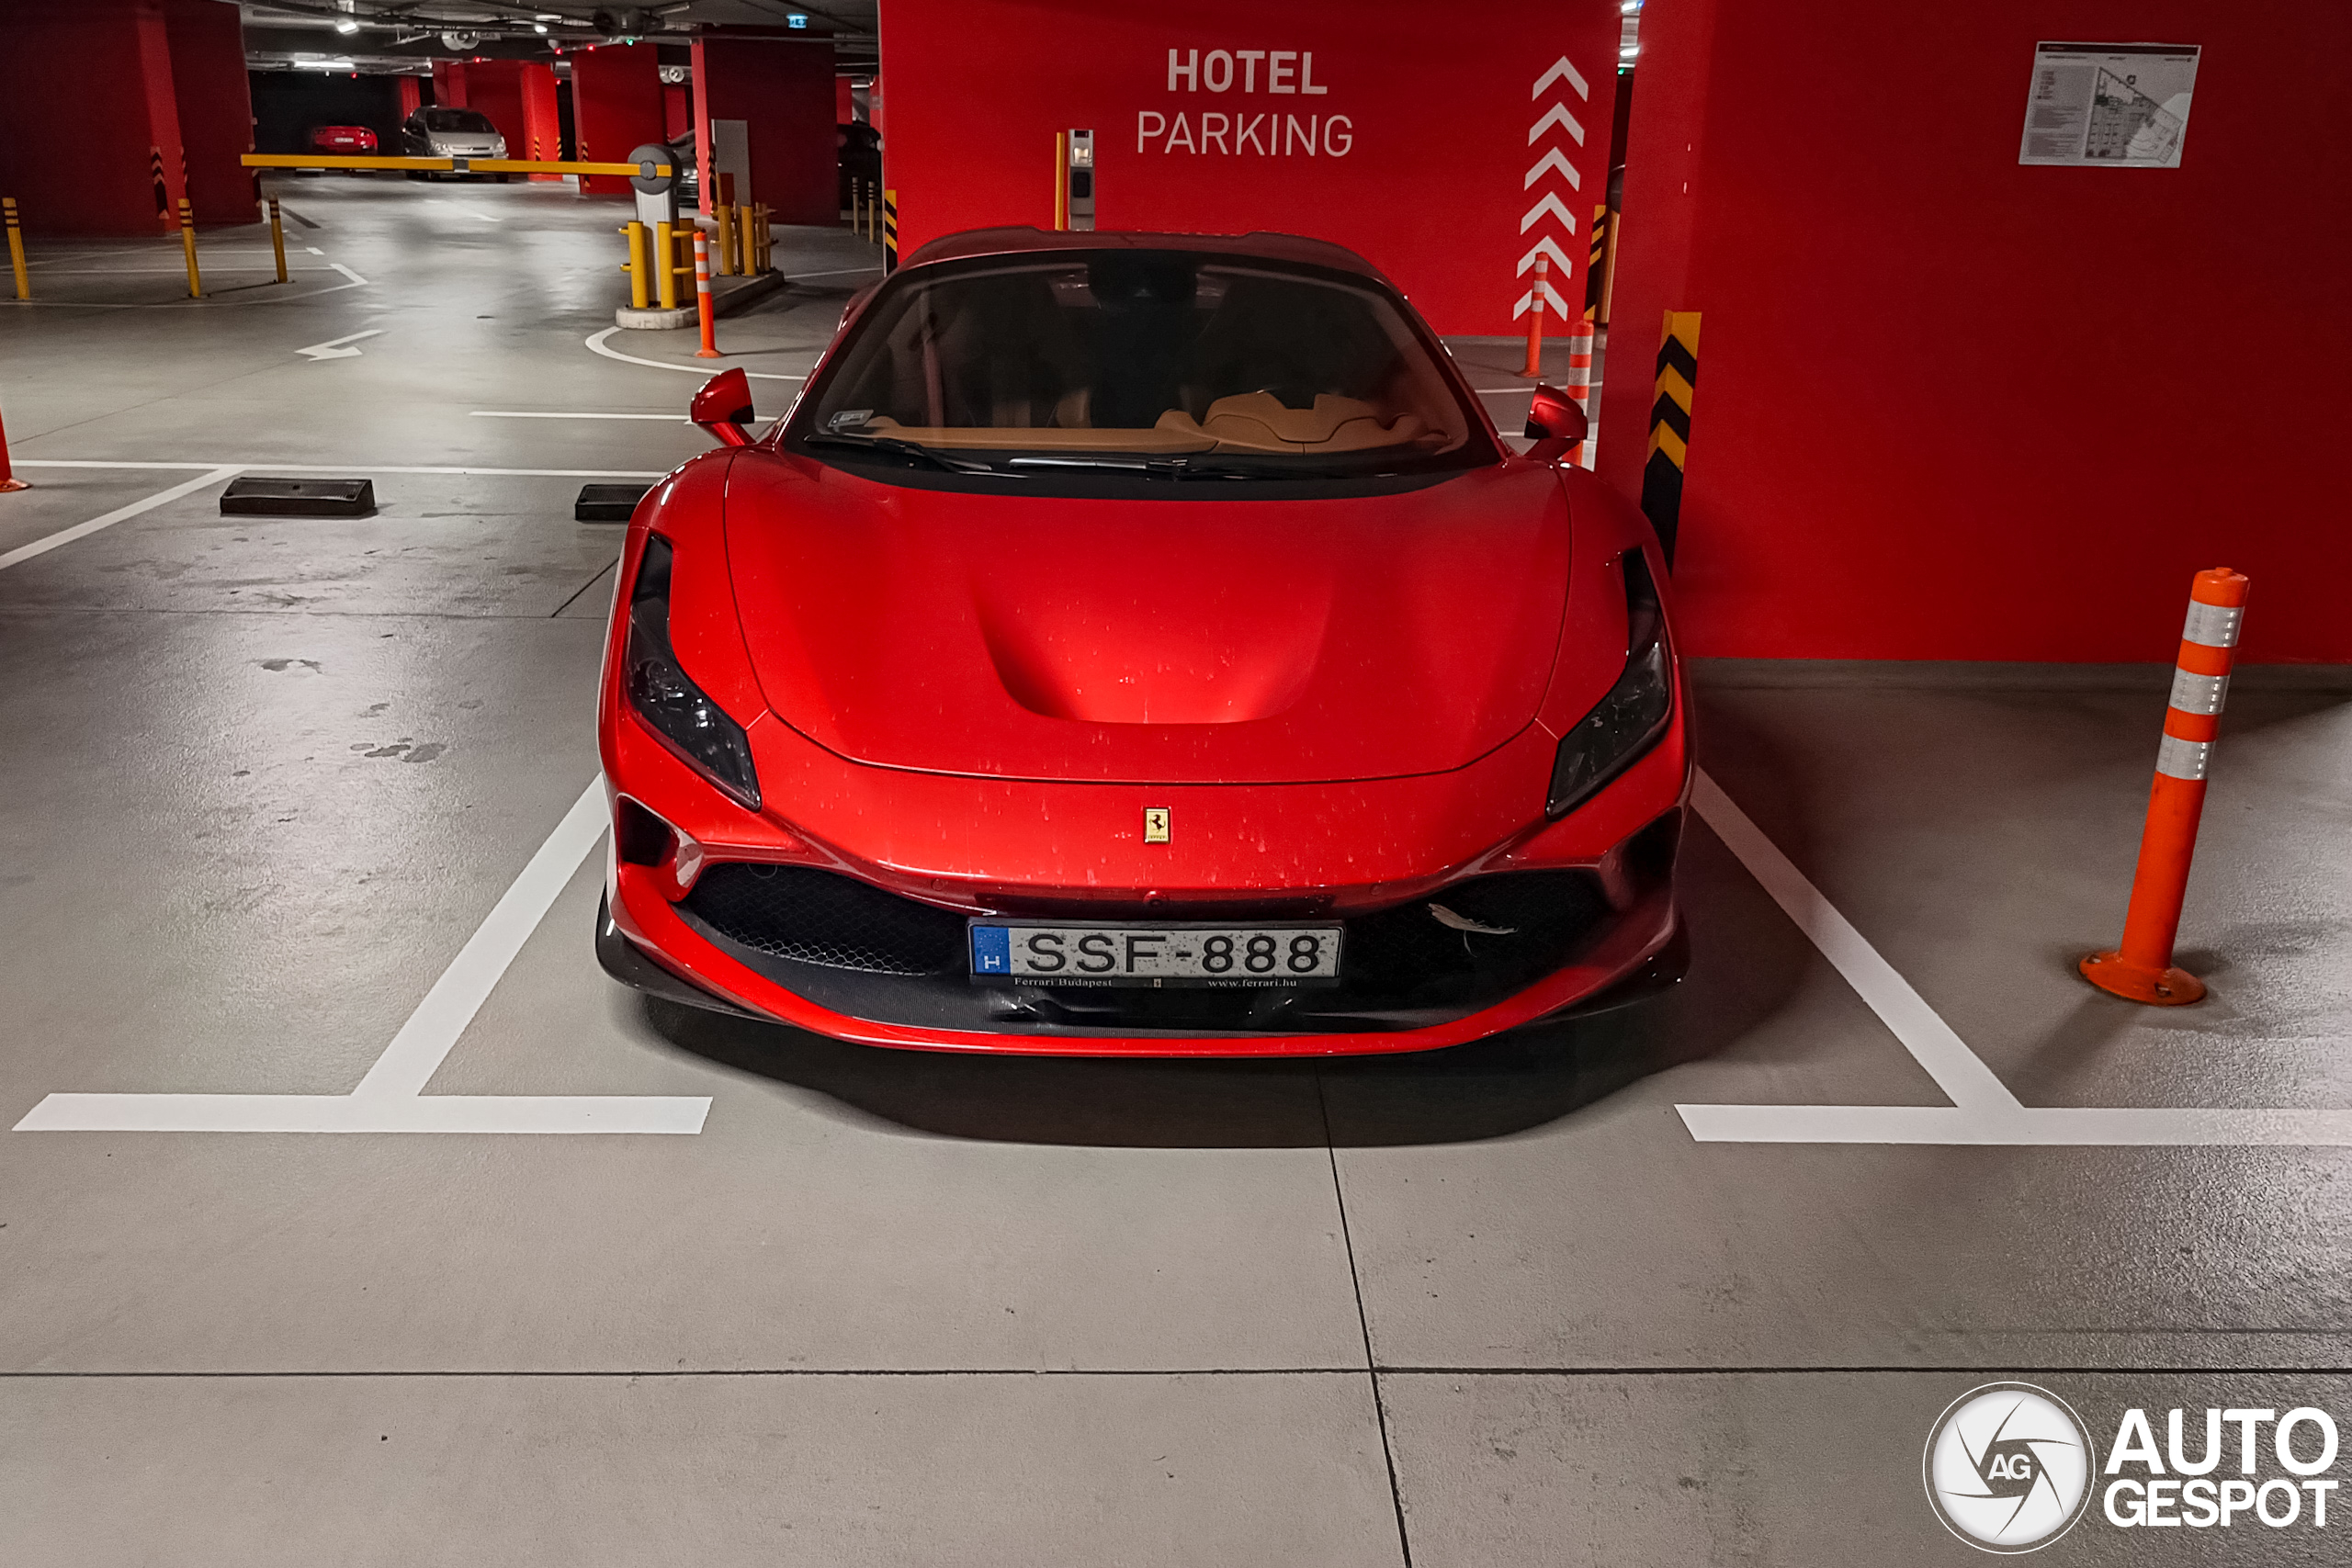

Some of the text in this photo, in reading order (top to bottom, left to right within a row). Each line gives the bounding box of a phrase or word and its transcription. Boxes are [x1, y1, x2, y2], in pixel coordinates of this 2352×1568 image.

[1168, 49, 1328, 95] HOTEL
[1137, 111, 1353, 157] PARKING
[984, 933, 1320, 974] H SSF-888
[1014, 977, 1298, 988] Ferrari Budapest www.ferrari.hu
